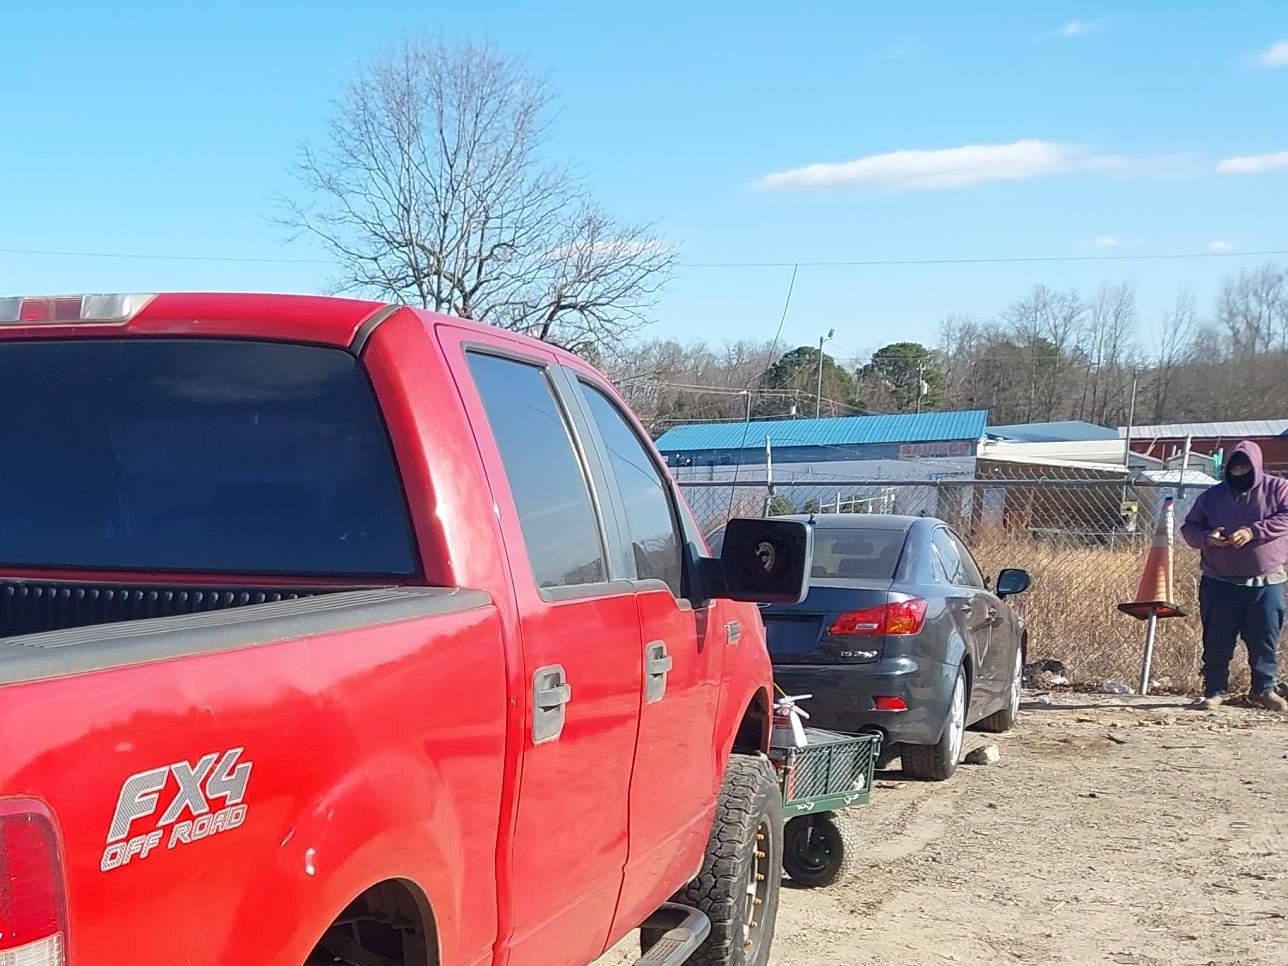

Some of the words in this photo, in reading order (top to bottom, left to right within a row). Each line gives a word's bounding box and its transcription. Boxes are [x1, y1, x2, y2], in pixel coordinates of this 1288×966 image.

[106, 747, 253, 844] FX4
[100, 829, 164, 873] OFF
[167, 804, 249, 850] ROAD
